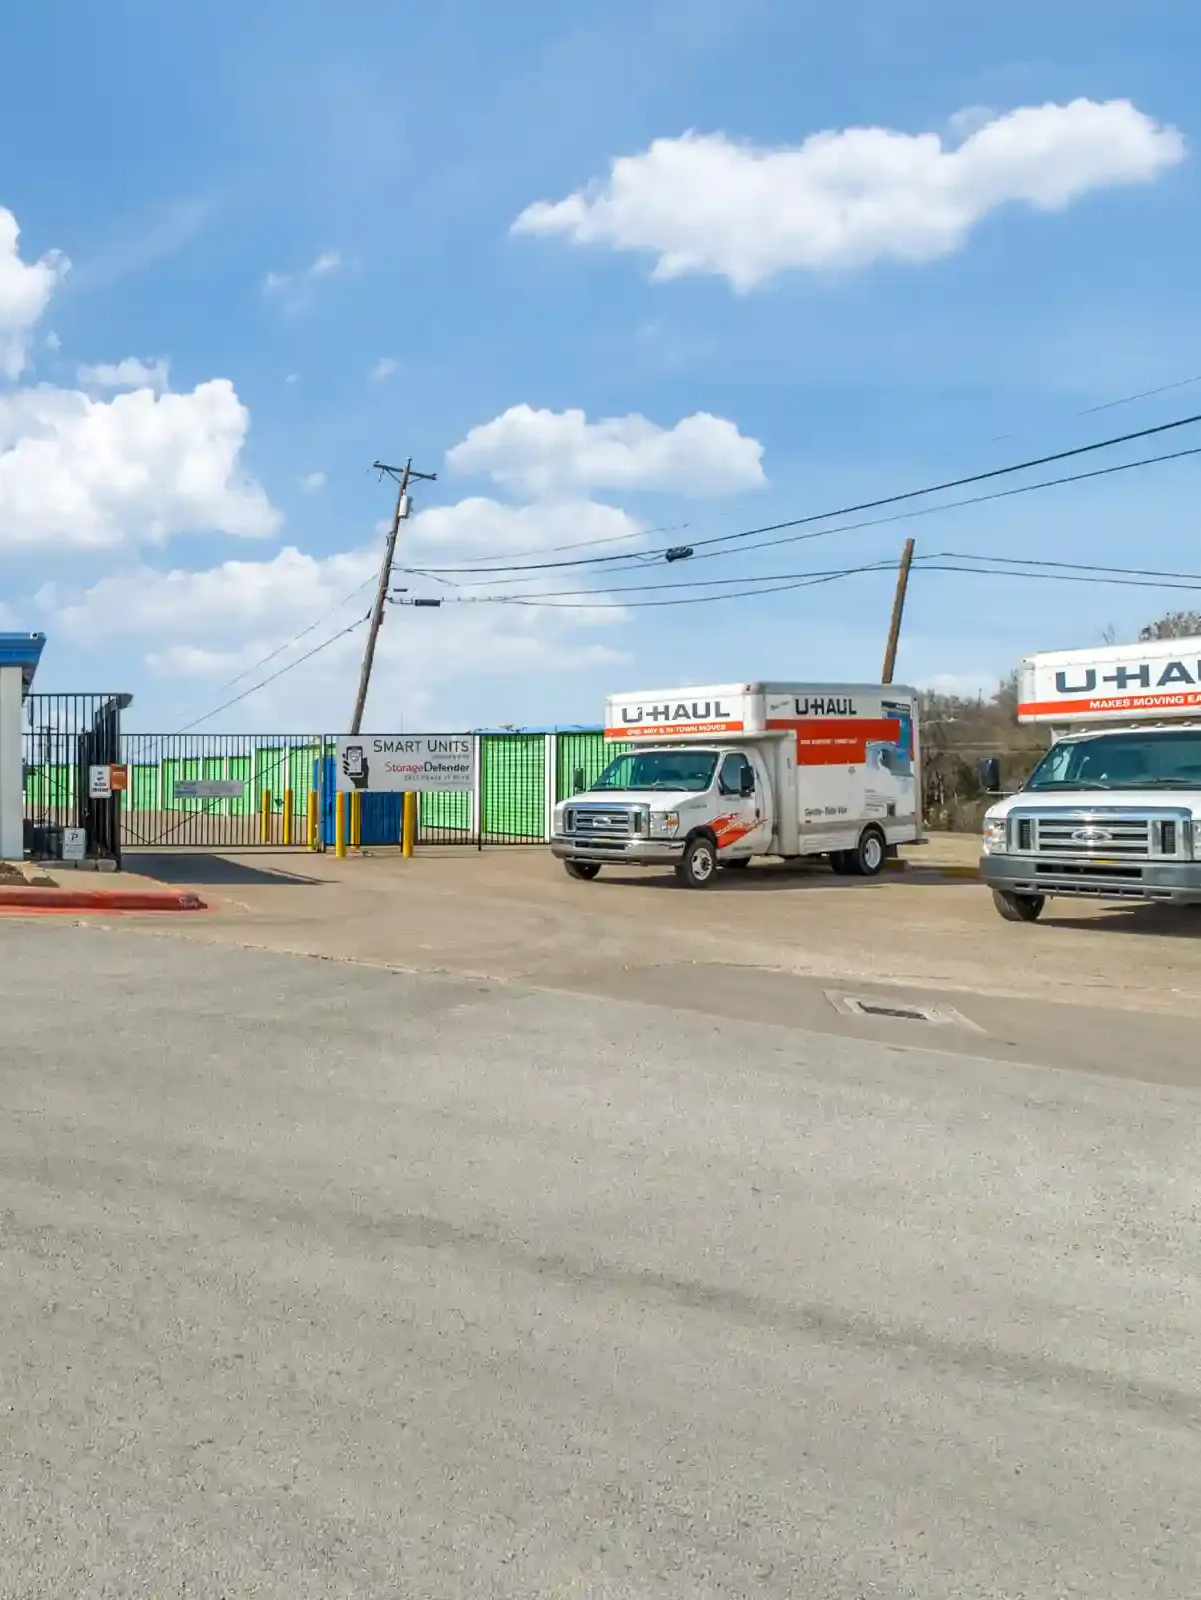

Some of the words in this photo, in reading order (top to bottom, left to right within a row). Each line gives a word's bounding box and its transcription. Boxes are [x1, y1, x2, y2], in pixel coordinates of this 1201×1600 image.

[1055, 659, 1201, 693] U-HA
[796, 698, 857, 715] U-HAUL
[1090, 699, 1131, 709] MAKES
[1133, 695, 1184, 706] MOVING
[621, 701, 730, 723] U-HAUL
[373, 740, 422, 754] SMART
[427, 740, 470, 753] UNITS
[385, 761, 470, 773] StorageDefender
